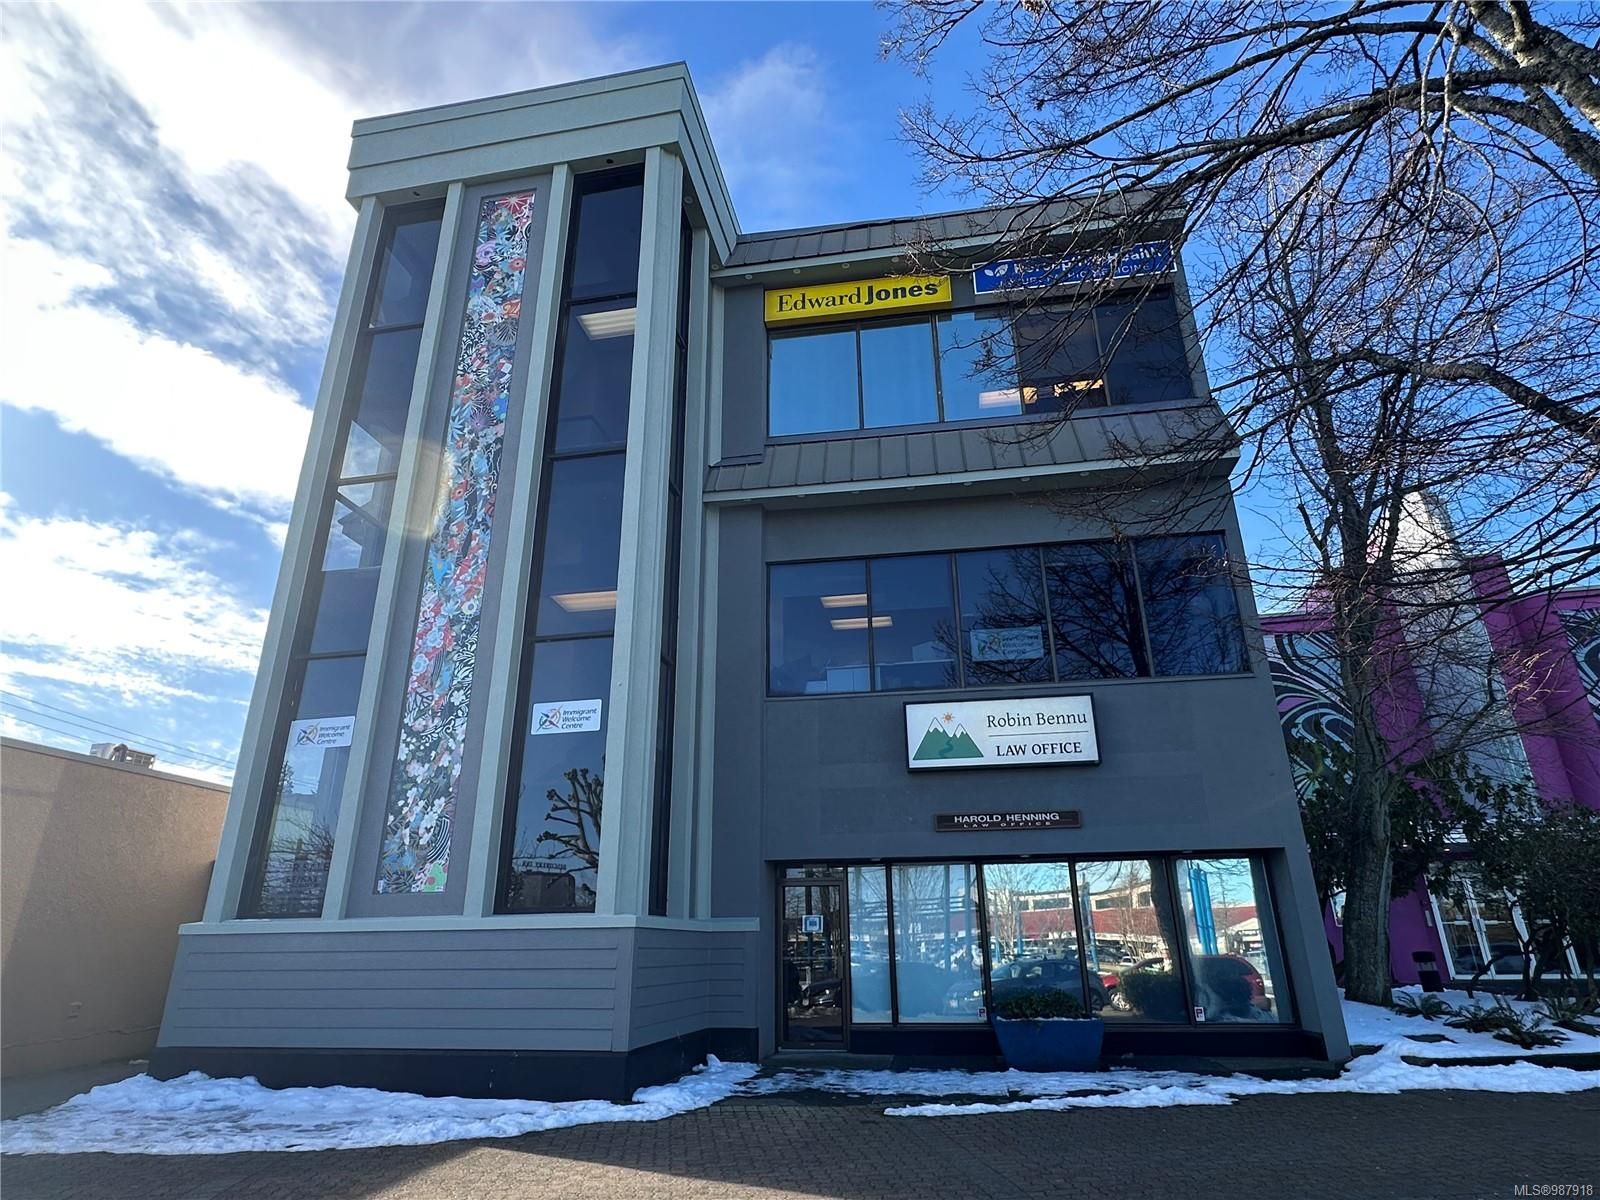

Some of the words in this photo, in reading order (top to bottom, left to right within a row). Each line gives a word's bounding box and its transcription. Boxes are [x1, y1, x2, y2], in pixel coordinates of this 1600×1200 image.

[776, 283, 862, 314] Edward
[563, 707, 597, 717] Immigrant
[561, 722, 583, 730] Centre
[987, 713, 1031, 728] Robin
[1036, 712, 1088, 726] Bennu
[996, 743, 1027, 757] LAW
[1031, 742, 1082, 756] OFFICE
[954, 815, 1001, 824] HAROLD
[1006, 812, 1060, 822] HENNING
[1000, 820, 1052, 828] OFFICE
